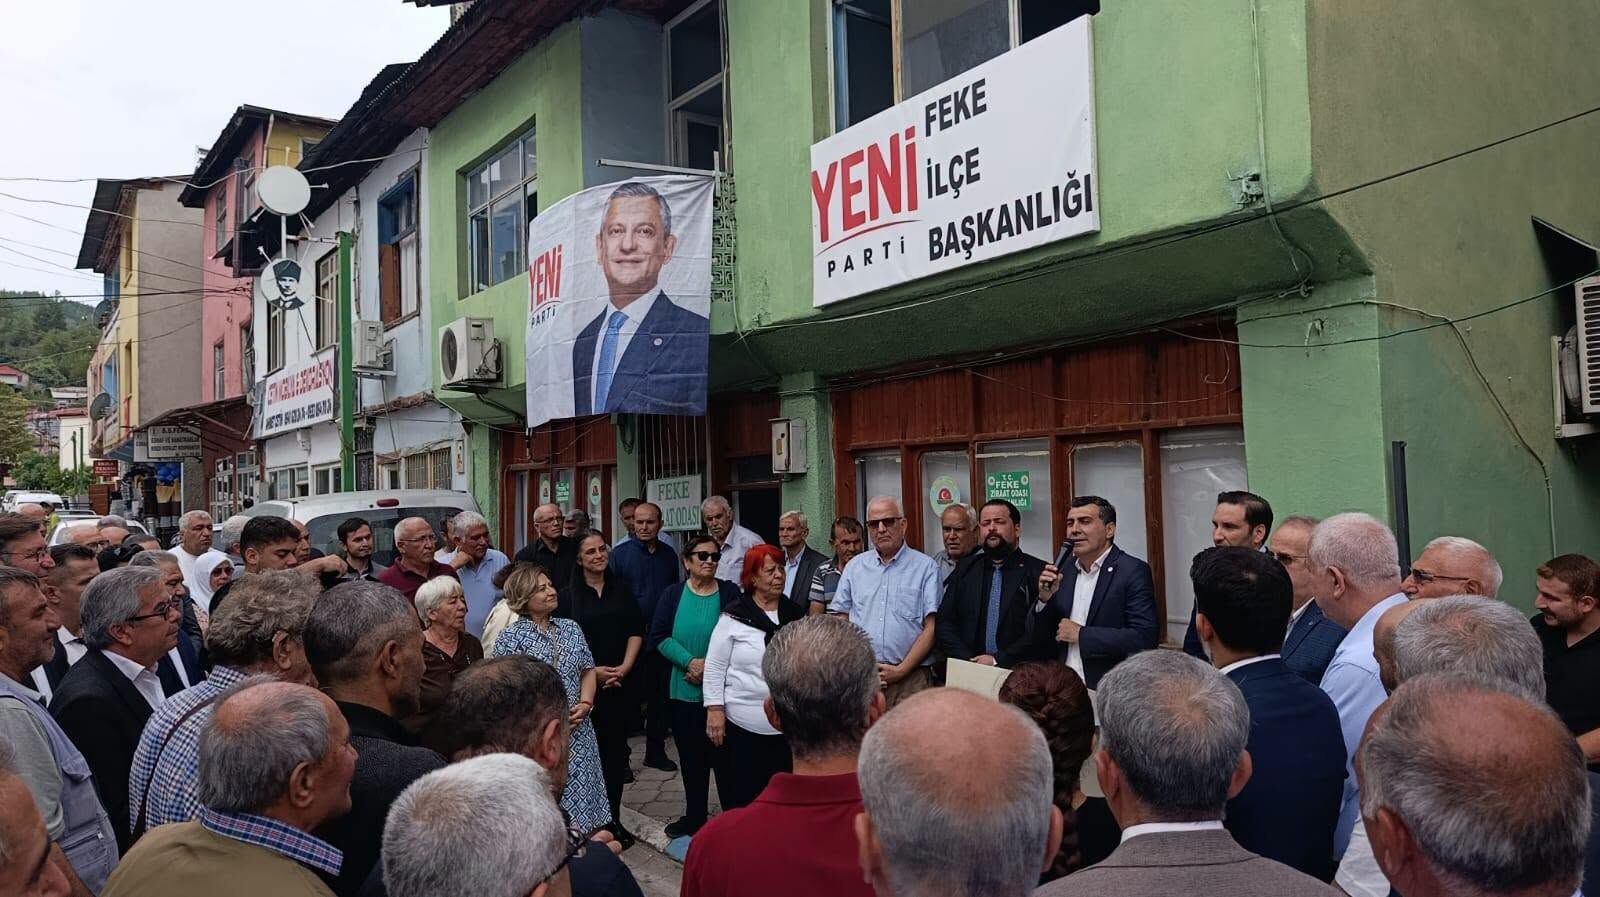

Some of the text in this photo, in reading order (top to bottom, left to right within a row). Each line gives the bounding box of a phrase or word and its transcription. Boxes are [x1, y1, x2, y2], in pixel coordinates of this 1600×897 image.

[925, 78, 987, 138] FEKE
[926, 147, 981, 200] İLÇE
[929, 170, 1093, 261] BAŞKANLIĞI
[658, 480, 690, 501] FEKE
[995, 480, 1019, 488] FEKE
[1011, 489, 1028, 497] ODASI
[675, 504, 700, 526] ODASI
